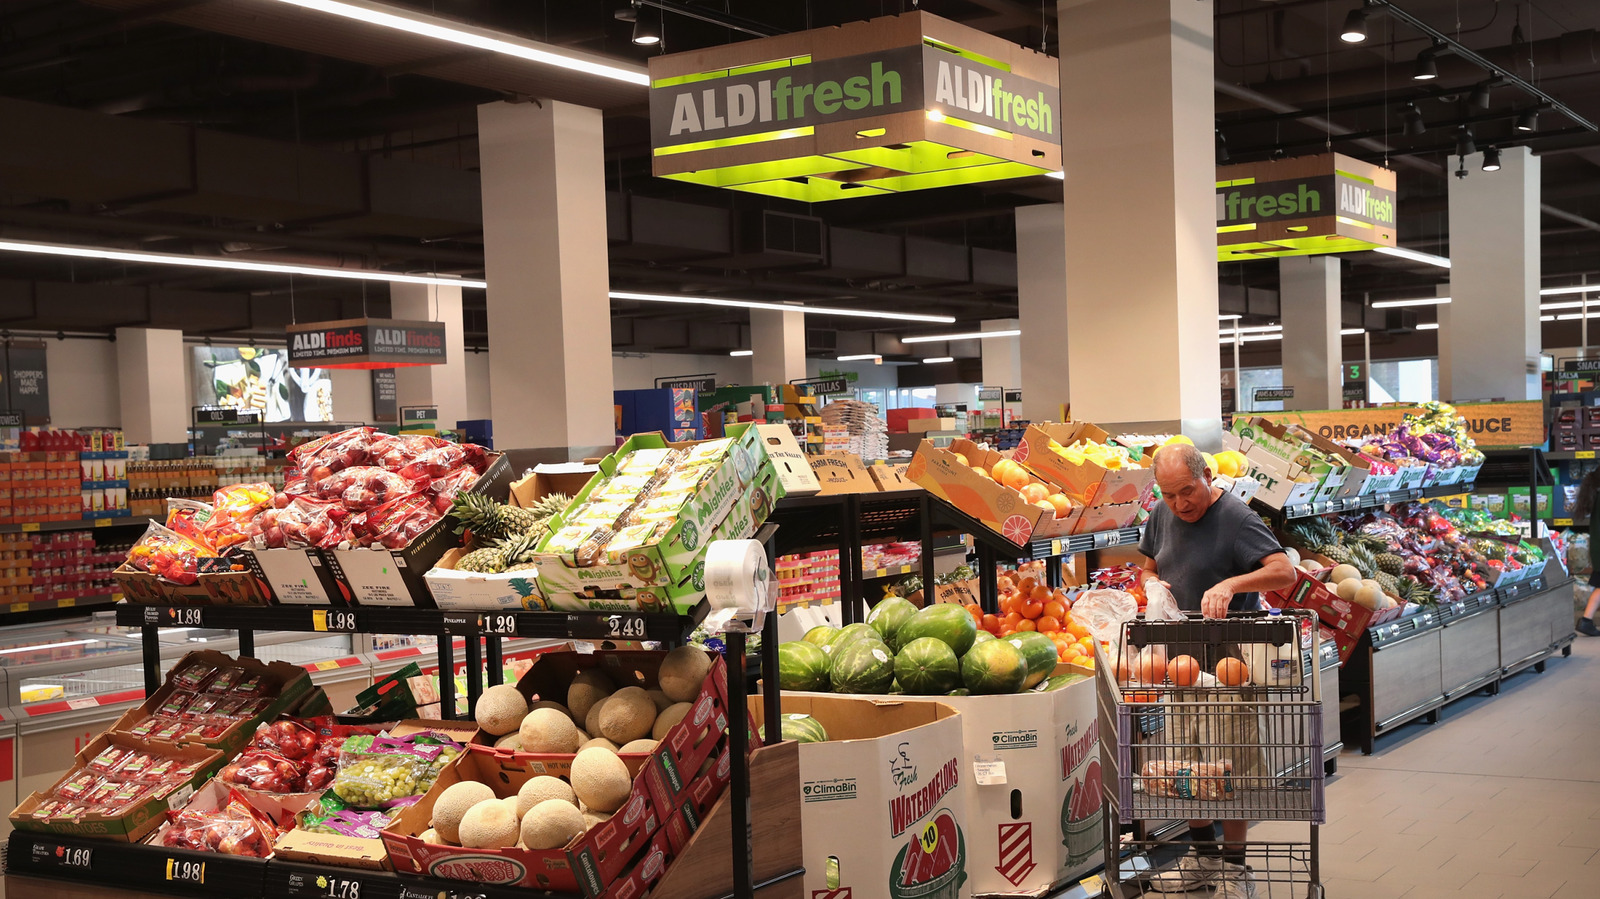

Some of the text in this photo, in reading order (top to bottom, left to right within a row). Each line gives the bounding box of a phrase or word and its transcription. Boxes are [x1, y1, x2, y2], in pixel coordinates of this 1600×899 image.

[669, 61, 902, 136] ALDIfresh
[935, 60, 1053, 135] ALDIfresh
[1216, 184, 1320, 221] Ifresh
[1340, 182, 1393, 223] ALDIfresh
[293, 329, 363, 350] ALDIfinds
[374, 328, 441, 348] ALDIfinds
[13, 370, 44, 379] SHOPPERS
[1349, 365, 1360, 379] 3
[19, 386, 39, 394] HAPPY.
[20, 379, 38, 387] MADE
[813, 381, 840, 393] RTILLAS
[210, 411, 224, 420] OILS
[416, 411, 426, 419] PET
[1318, 422, 1396, 440] ORGANI
[1255, 436, 1291, 460] Mighties
[810, 458, 848, 469] FARM FRESH
[698, 476, 735, 527] Mighties
[578, 569, 623, 580] Mighties
[588, 601, 632, 611] Mighties
[176, 608, 201, 625] 1.89
[327, 612, 356, 630] 1.98
[484, 615, 515, 633] 1.29
[609, 617, 645, 637] 2.49
[1000, 733, 1038, 743] ClimaBin
[899, 765, 918, 791] Fresh
[813, 782, 857, 794] ClimaBin
[890, 757, 959, 836] WATERMELONS
[52, 823, 108, 834] TOMATOES
[923, 825, 936, 849] 10
[64, 847, 90, 866] 1.69
[172, 861, 200, 881] 1.98
[580, 852, 600, 895] Cantaloupes
[328, 879, 359, 899] 1.78
